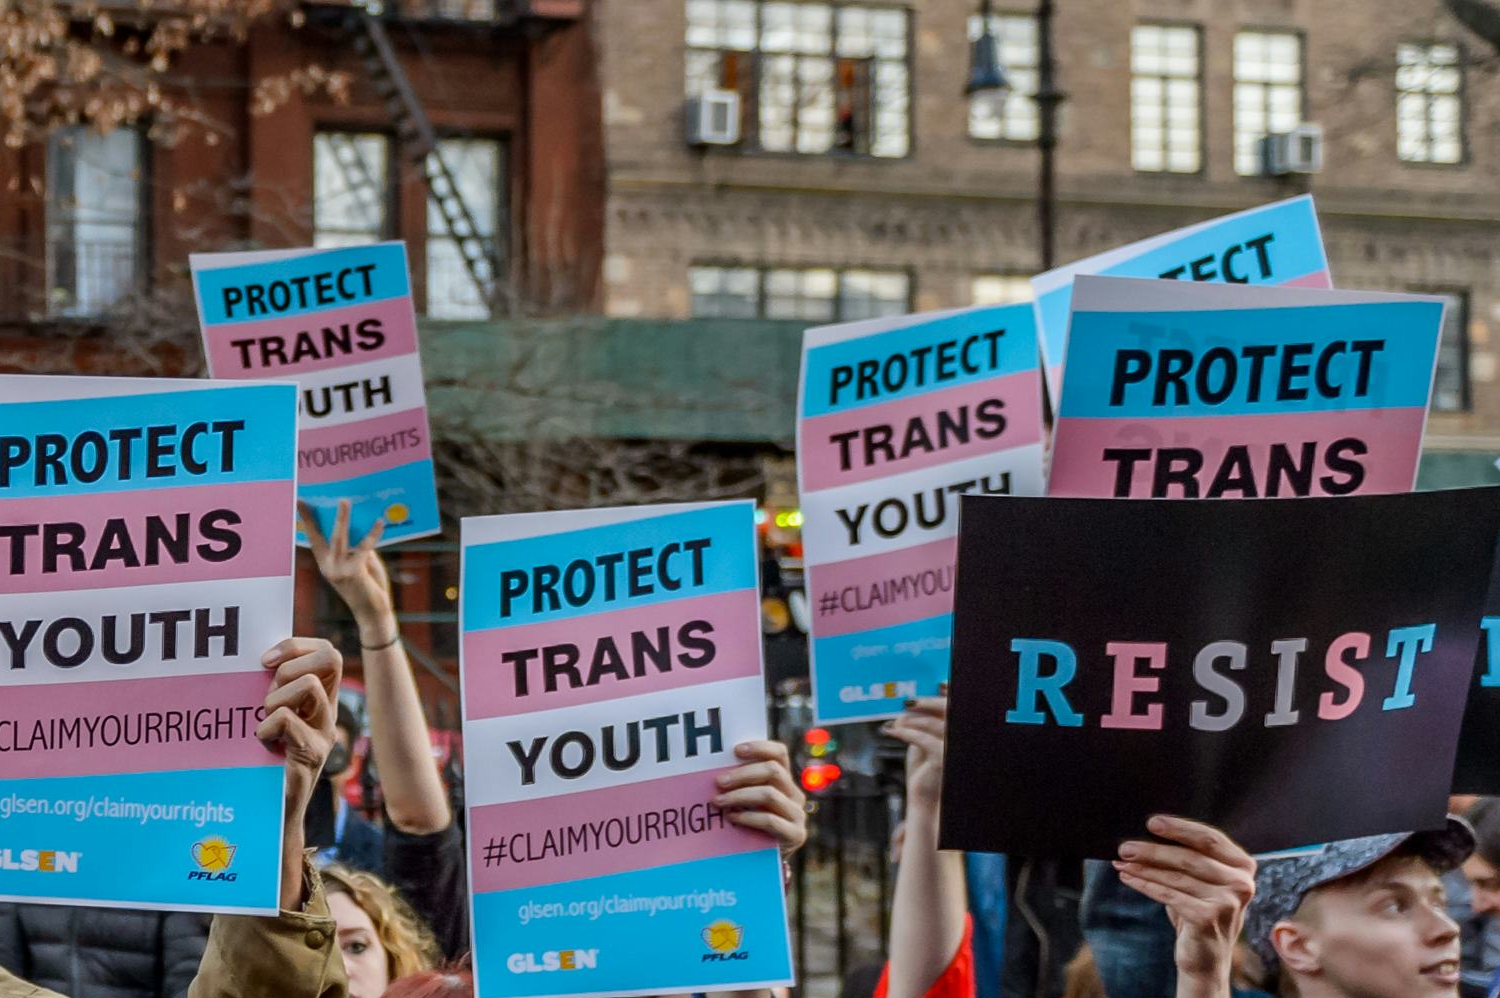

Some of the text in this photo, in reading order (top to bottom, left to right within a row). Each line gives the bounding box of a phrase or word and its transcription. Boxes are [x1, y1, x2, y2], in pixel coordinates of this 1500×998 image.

[222, 264, 376, 318] PROTECT
[231, 319, 385, 368] TRANS
[830, 329, 1006, 406] PROTECT
[298, 375, 394, 419] UTH
[1109, 339, 1386, 406] PROTECT
[298, 428, 421, 469] YOURRIGHTS
[829, 398, 1008, 472] TRANS
[1102, 437, 1369, 498] TRANS
[500, 538, 712, 618] PROTECT
[819, 564, 955, 616] #CLAIMYOU
[502, 620, 717, 698] TRANS
[1005, 623, 1436, 732] RESIST
[506, 707, 724, 786] YOUTH
[0, 793, 235, 828] glsen.org/claimyourrights
[483, 801, 727, 868] #CLAIMYOURRIGH
[188, 871, 237, 882] PFLAG
[518, 888, 737, 925] glsen.org/claimyourrights
[507, 949, 597, 974] GLSEN
[701, 951, 749, 962] PFLAG
